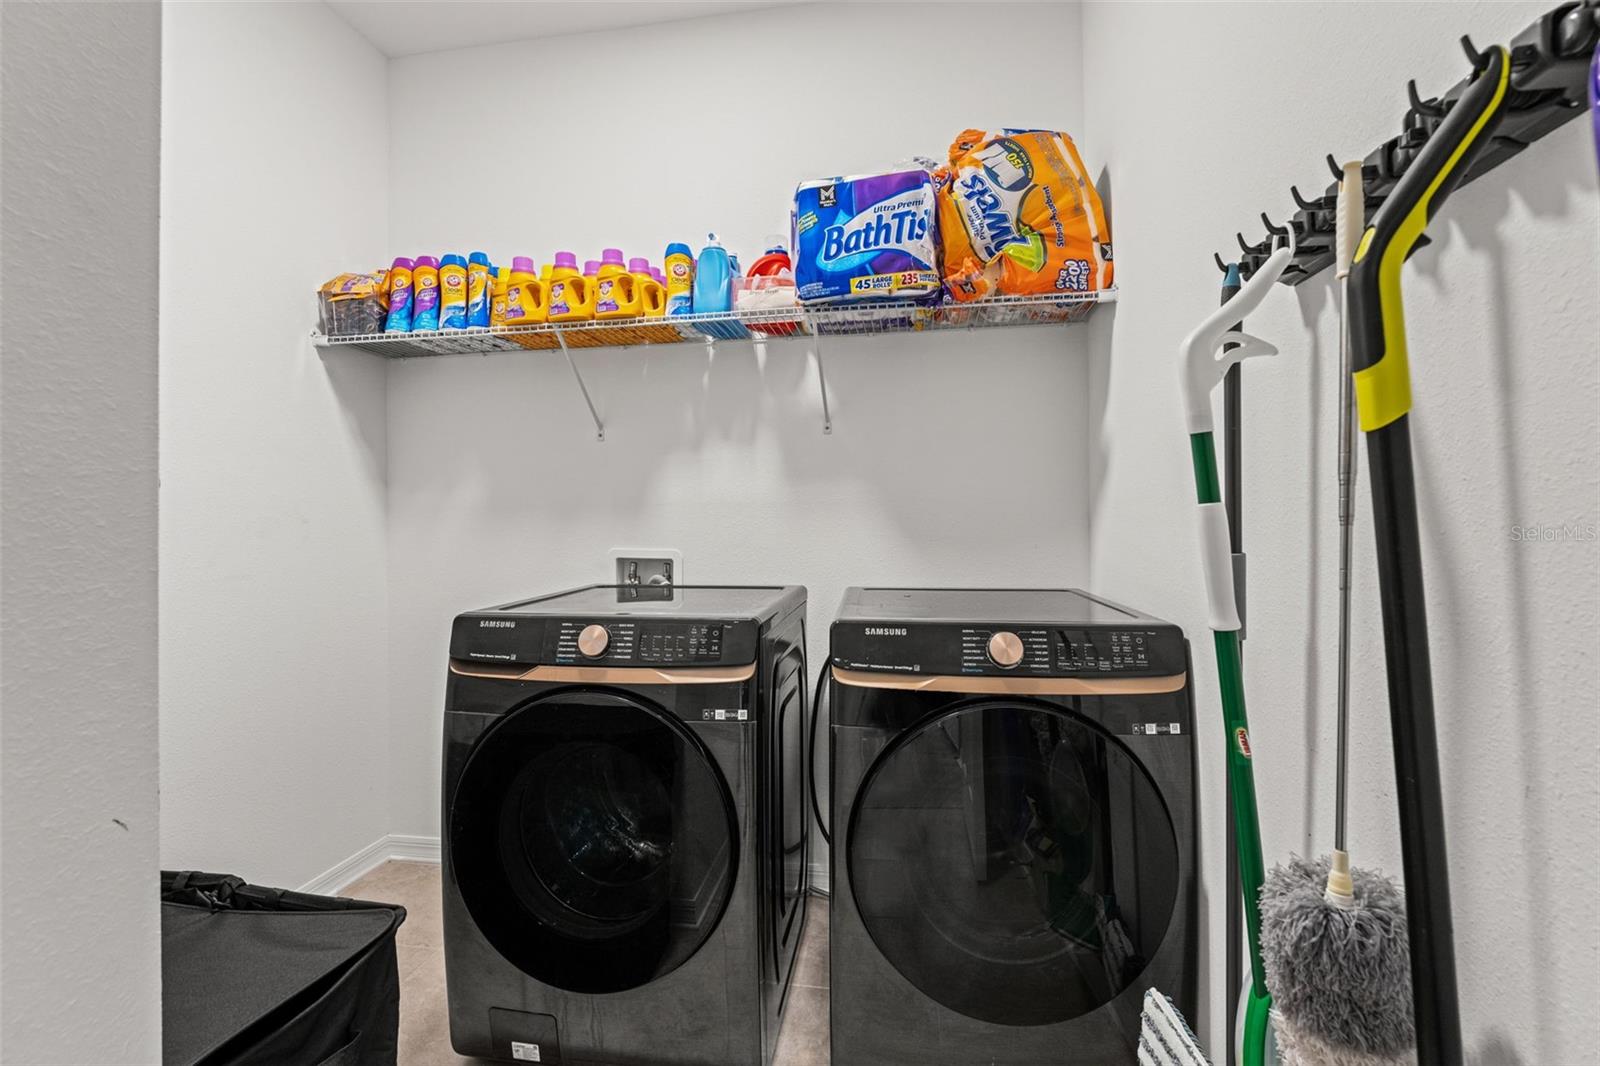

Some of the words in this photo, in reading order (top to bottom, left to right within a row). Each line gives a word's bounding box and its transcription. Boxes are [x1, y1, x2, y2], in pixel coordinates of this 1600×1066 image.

[1005, 153, 1025, 169] 150
[873, 202, 896, 214] Ultra
[1054, 222, 1064, 248] Strong
[855, 279, 871, 290] 45
[872, 275, 892, 284] LARGE
[901, 274, 918, 285] 235
[1065, 260, 1077, 290] 2200
[1077, 260, 1090, 290] SHEETS
[480, 620, 516, 628] SAMSUNG
[865, 627, 907, 636] SAMSUNG
